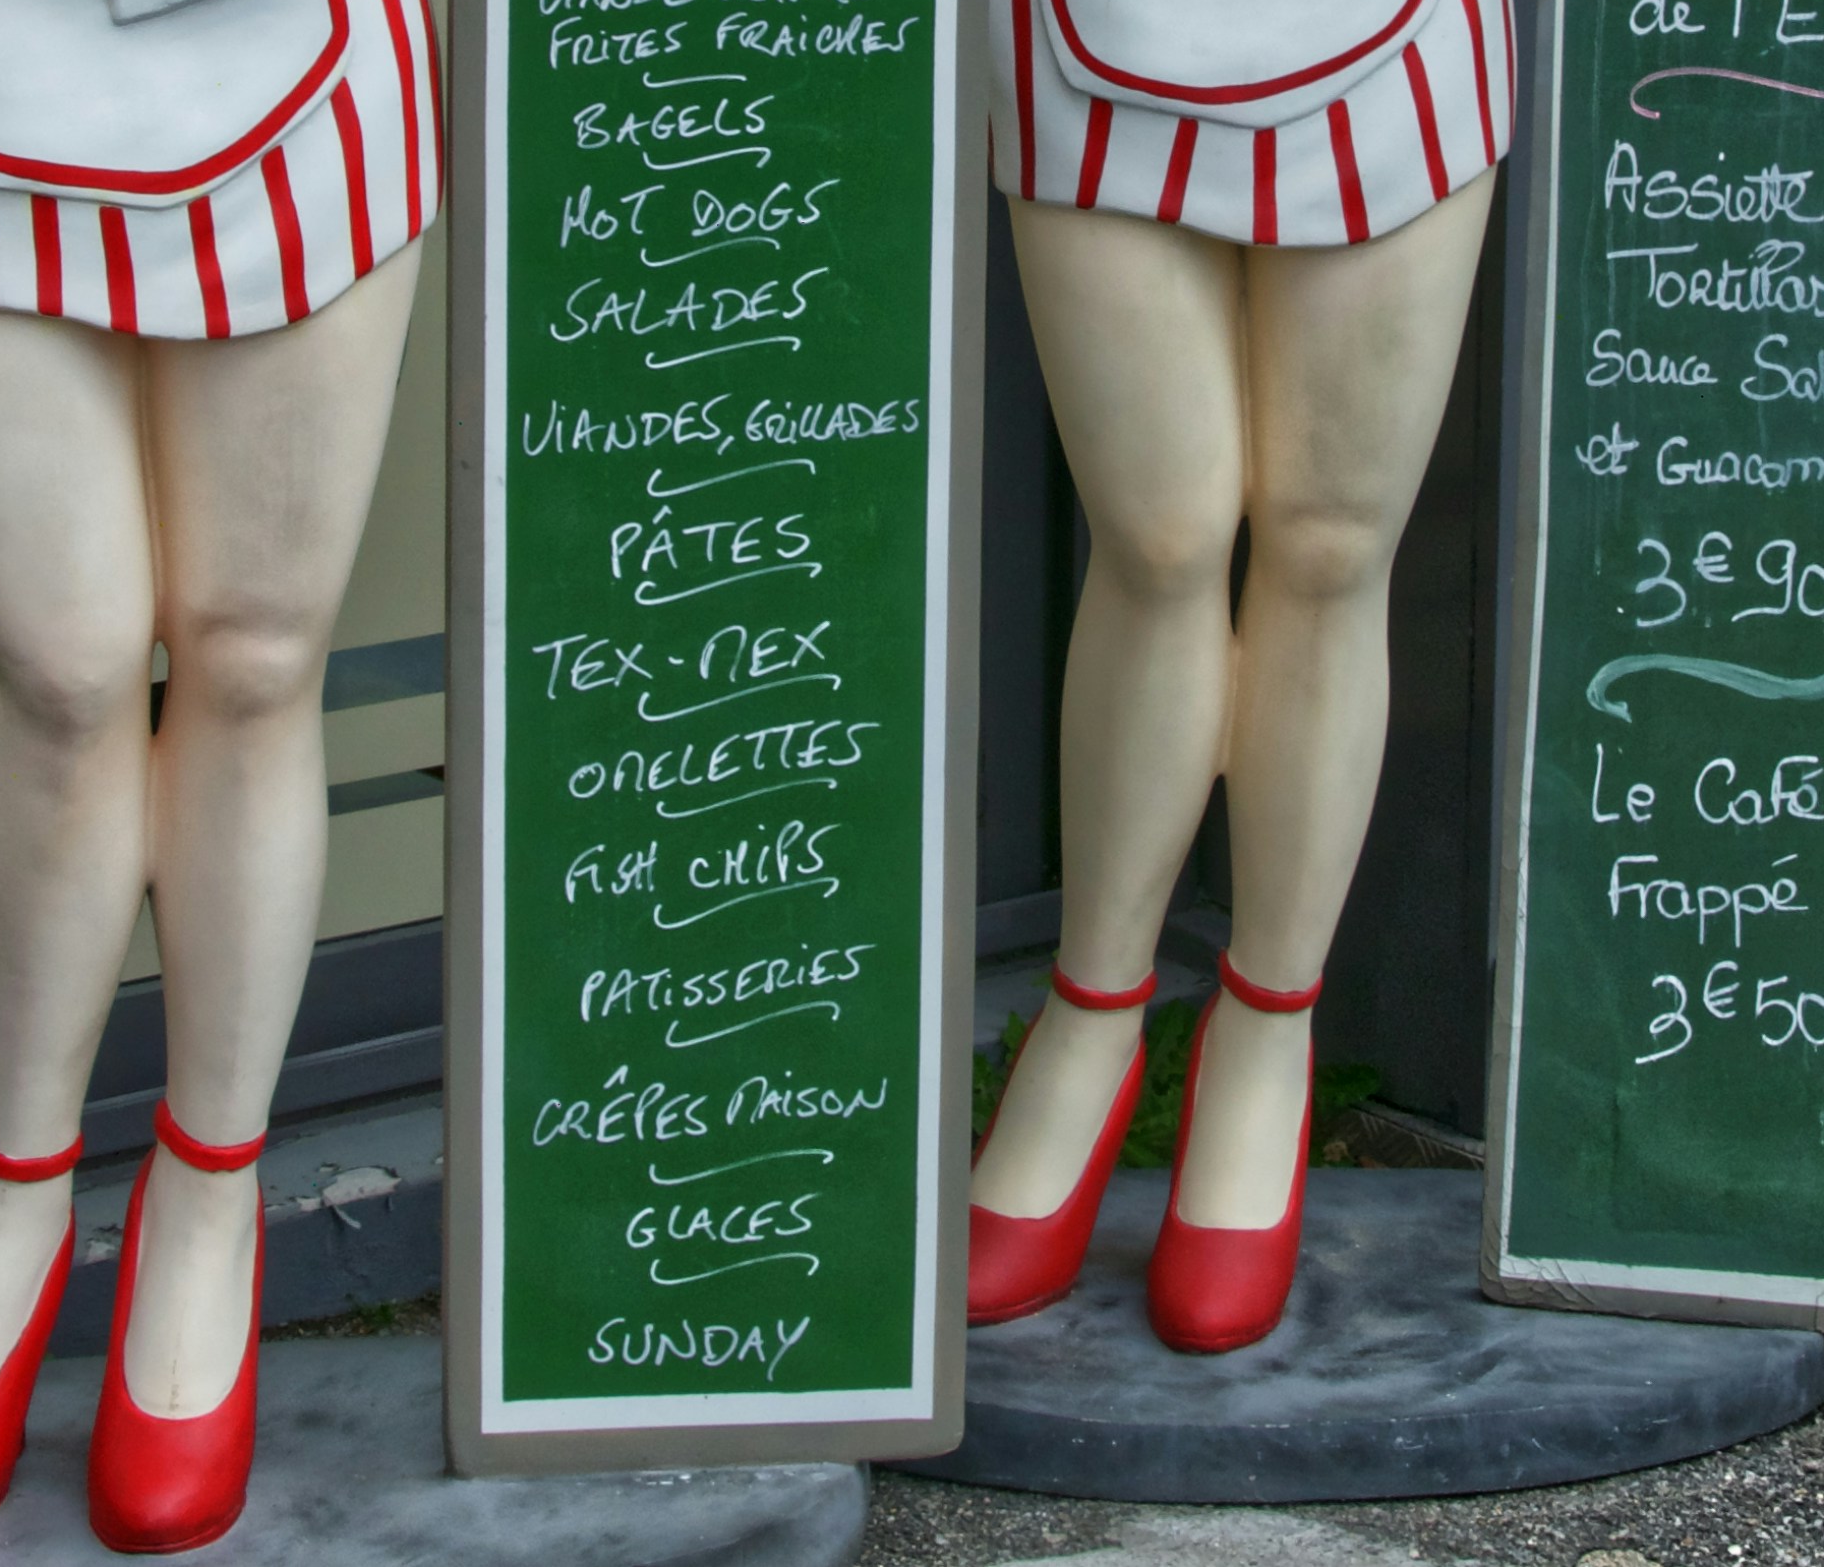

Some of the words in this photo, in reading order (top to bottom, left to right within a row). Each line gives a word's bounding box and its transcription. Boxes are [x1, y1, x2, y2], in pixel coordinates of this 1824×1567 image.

[548, 15, 690, 69] FRITES
[572, 94, 775, 150] BAGELS
[560, 184, 666, 249] HOT
[691, 177, 843, 238] DOGS
[549, 266, 830, 343] SALADES
[1584, 327, 1719, 388] Sauce
[1575, 422, 1640, 476] et
[610, 504, 811, 580] PÂTES
[567, 720, 882, 799] OMELETTES
[1590, 742, 1657, 824] Le
[688, 819, 842, 890] CHIPS
[1607, 853, 1810, 948] Frappé
[579, 942, 879, 1023] PATISSERIES
[531, 1064, 709, 1148] CRÊPES
[624, 1191, 824, 1249] GLACES
[587, 1315, 812, 1383] SUNDAY
